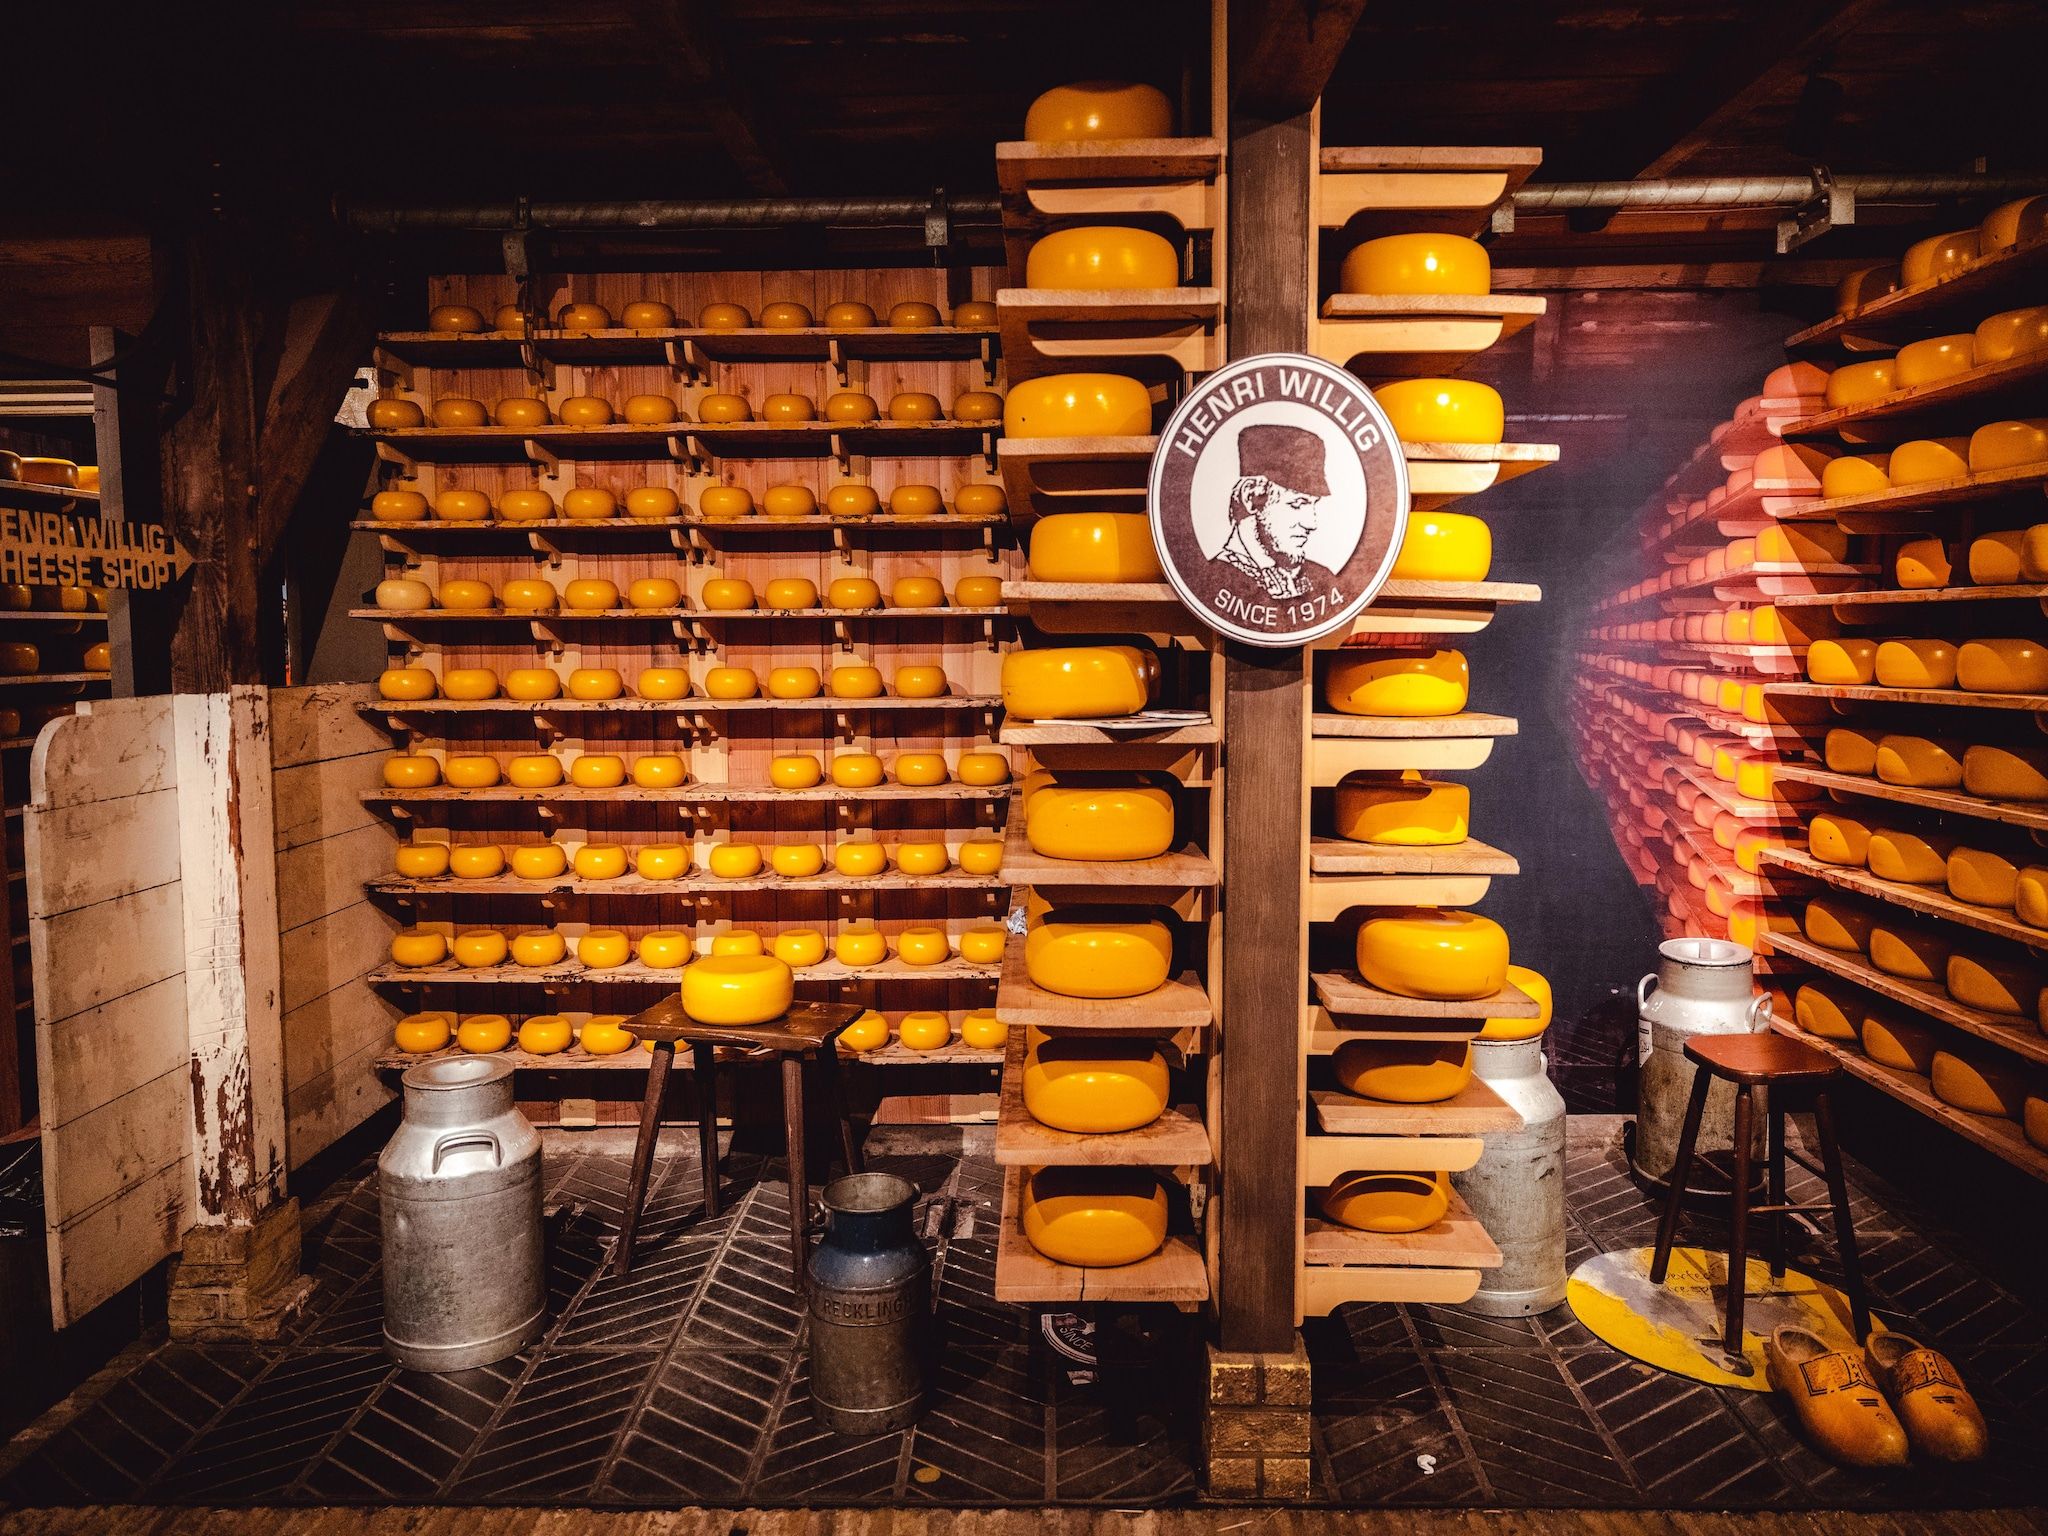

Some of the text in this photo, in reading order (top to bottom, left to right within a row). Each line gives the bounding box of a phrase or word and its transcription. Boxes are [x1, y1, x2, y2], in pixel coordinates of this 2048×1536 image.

[1175, 368, 1380, 459] HENRI WILLIG
[77, 516, 166, 554] WILLIG
[101, 558, 170, 590] SHOP
[1214, 587, 1344, 626] SINCE 1974
[1059, 1327, 1094, 1350] SINCE
